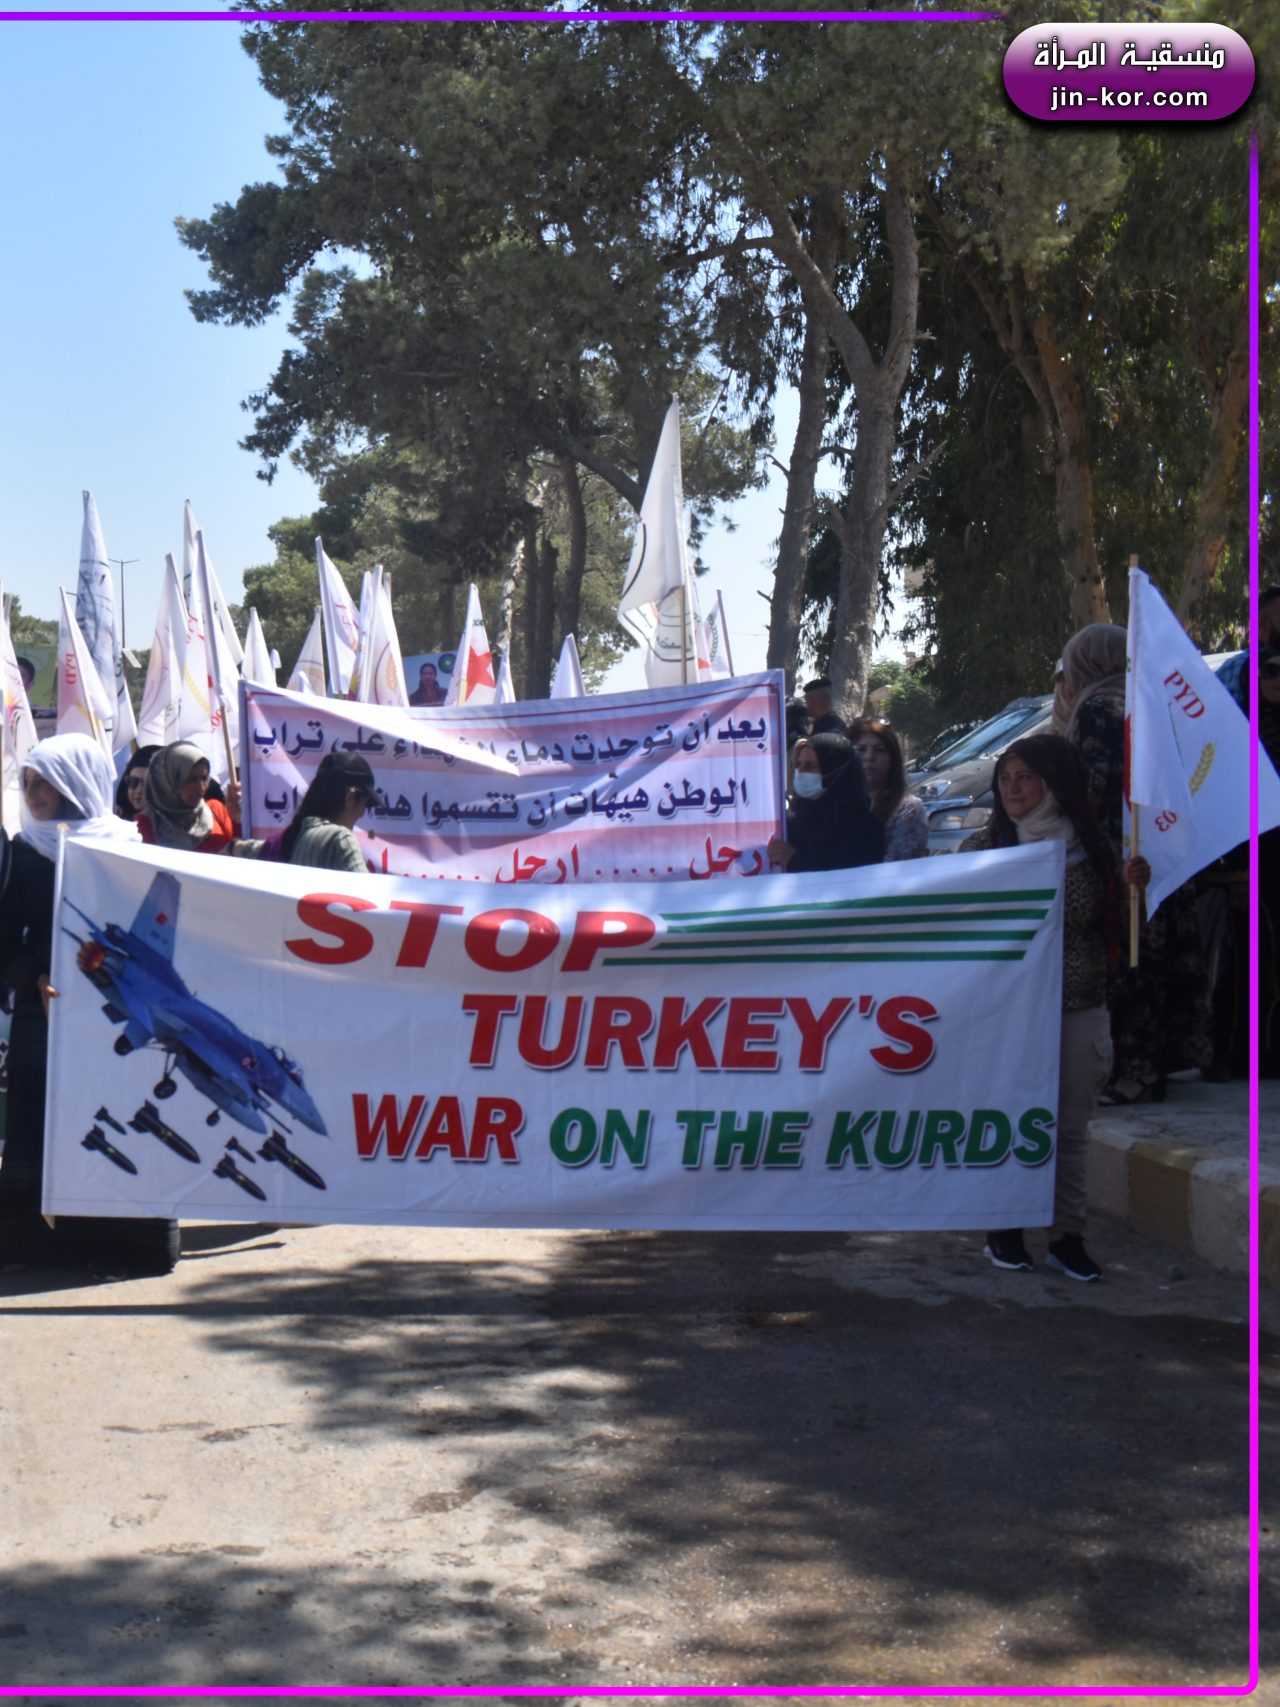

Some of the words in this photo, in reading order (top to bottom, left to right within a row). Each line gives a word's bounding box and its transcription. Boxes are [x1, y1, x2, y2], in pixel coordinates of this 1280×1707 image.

[1164, 669, 1206, 720] PYD
[252, 719, 325, 757] تراب
[331, 725, 385, 753] على
[505, 738, 564, 764] دماء
[571, 723, 673, 762] توحدت
[682, 712, 710, 751] أن
[717, 717, 767, 750] بعد
[421, 791, 520, 826] تقسموا
[526, 791, 556, 826] أن
[564, 786, 650, 821] هيهات
[657, 776, 749, 817] الوطن
[495, 843, 580, 884] ارحل
[689, 836, 770, 880] رحل
[285, 893, 657, 973] STOP
[462, 993, 939, 1073] TURKEY'S
[351, 1093, 523, 1162] WAR
[549, 1107, 651, 1168] ON
[675, 1110, 811, 1168] THE
[827, 1108, 1055, 1166] KURDS
